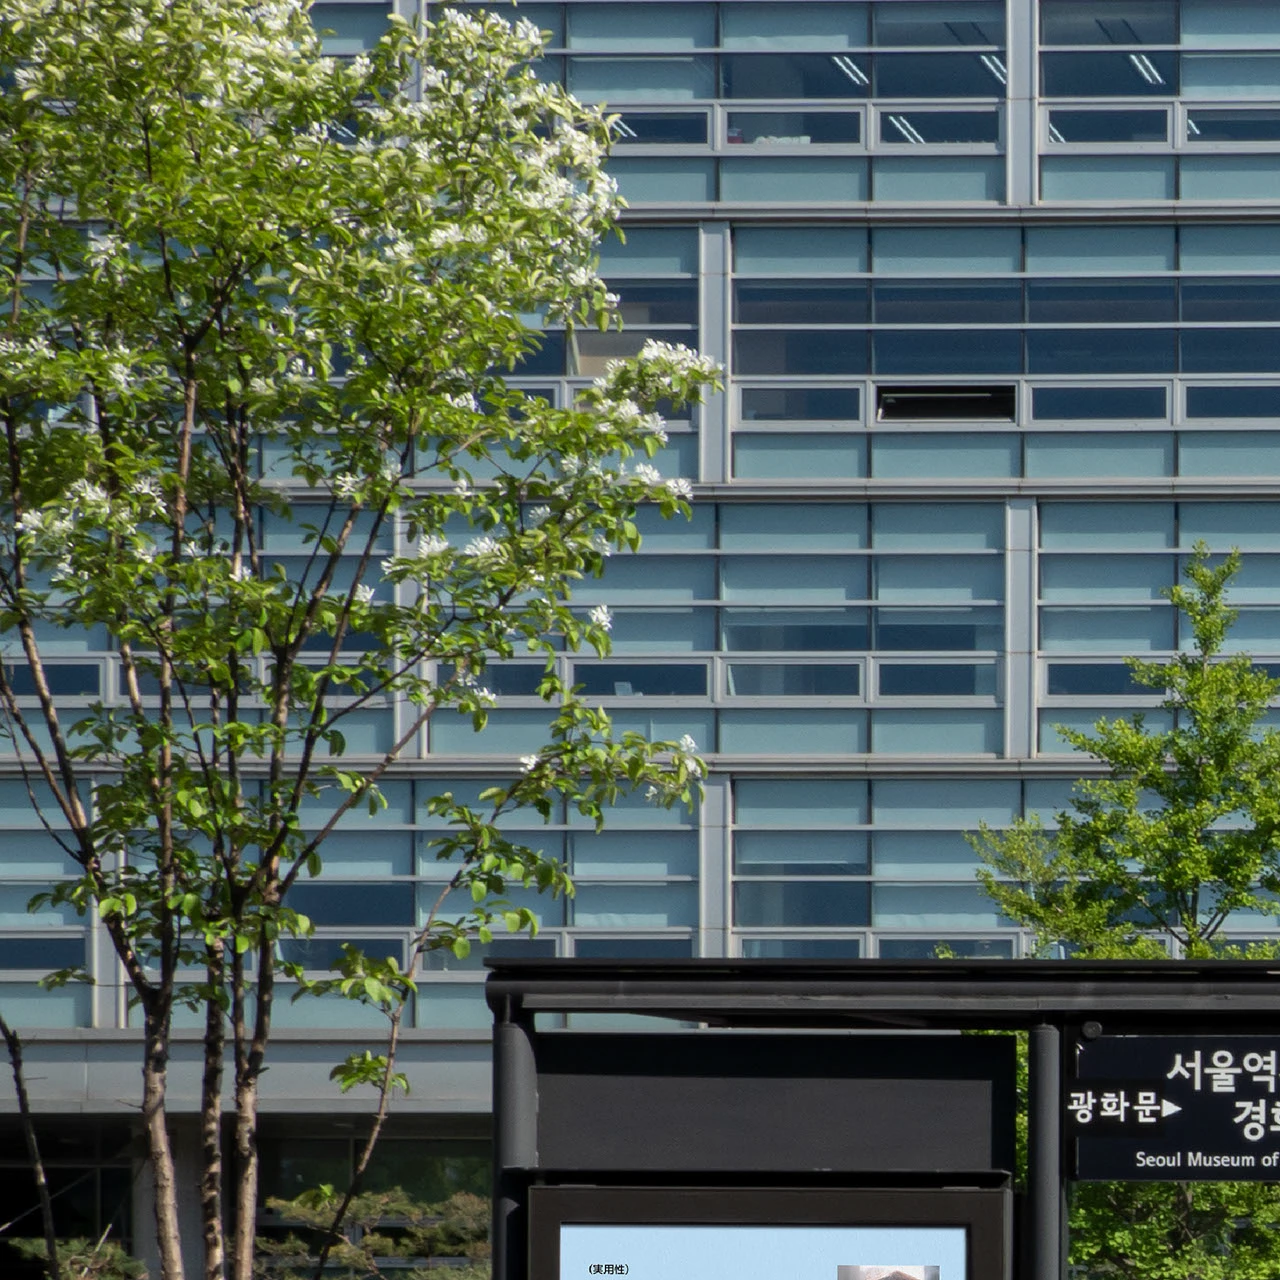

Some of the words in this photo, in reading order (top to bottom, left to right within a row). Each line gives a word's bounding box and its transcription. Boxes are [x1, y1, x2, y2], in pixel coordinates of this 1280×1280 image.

[1067, 1090, 1162, 1124] 광화문
[1136, 1151, 1181, 1168] Seoul
[1187, 1151, 1255, 1168] Museum
[1261, 1151, 1280, 1168] of
[588, 1263, 629, 1275] (実用性)
